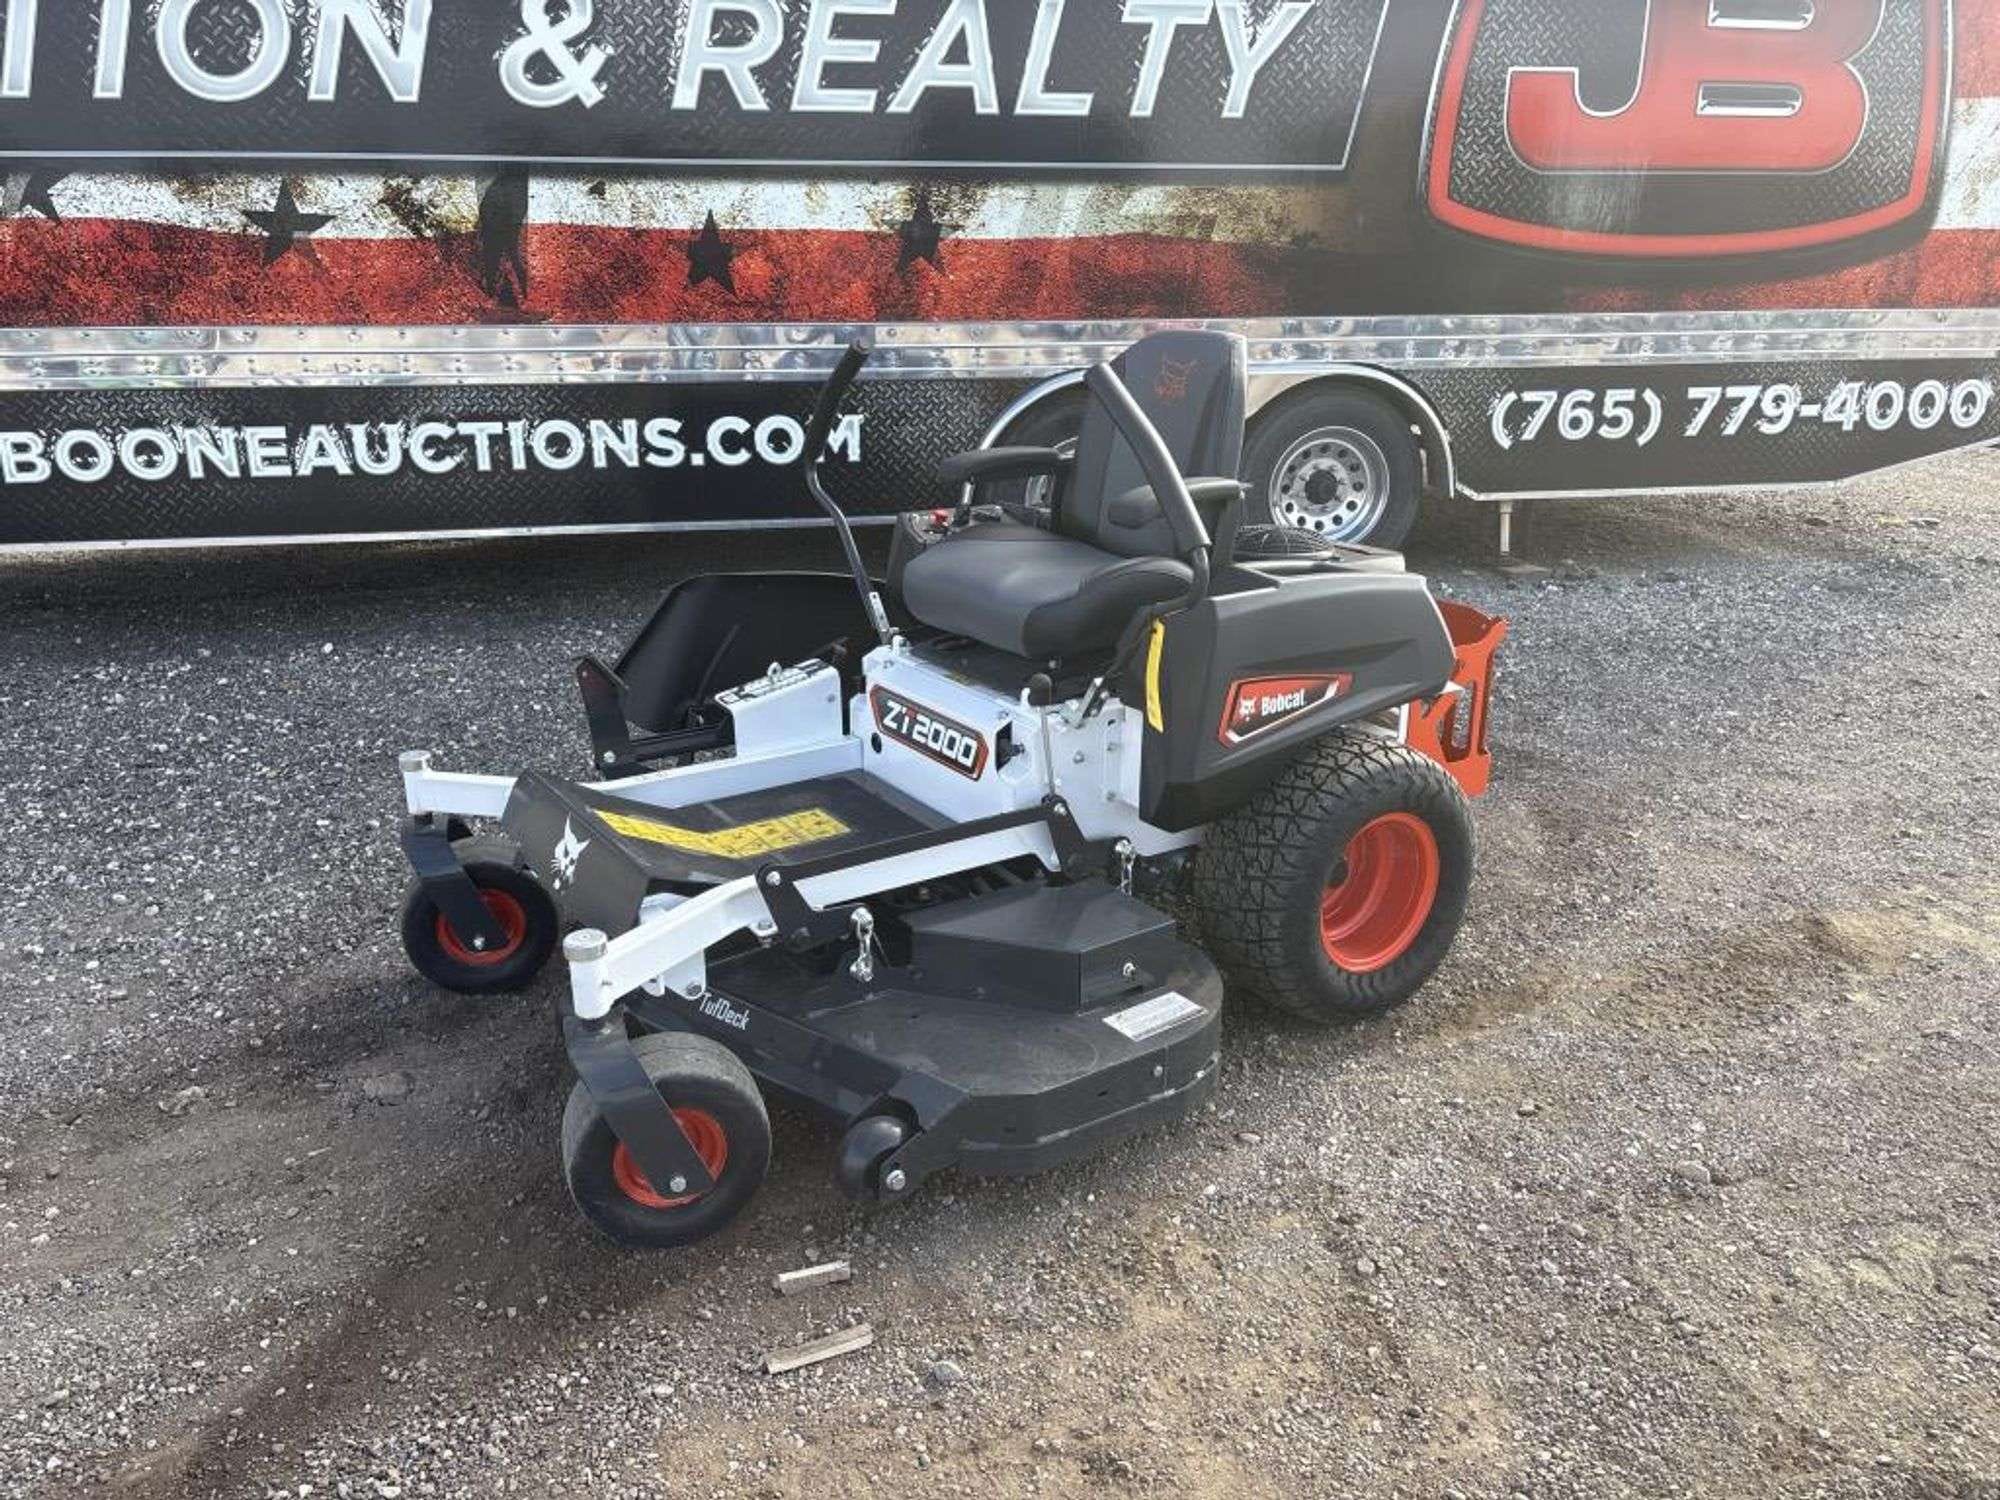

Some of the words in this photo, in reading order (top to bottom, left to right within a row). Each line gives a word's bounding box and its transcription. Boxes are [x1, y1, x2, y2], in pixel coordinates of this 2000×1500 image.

[500, 0, 608, 107] &
[672, 0, 1311, 118] REALTY
[1505, 0, 1886, 174] JB
[1491, 387, 1662, 450] (765)
[1684, 377, 1991, 436] 779-4000
[1261, 688, 1306, 716] Bobcat
[700, 992, 749, 1031] TufDeck
